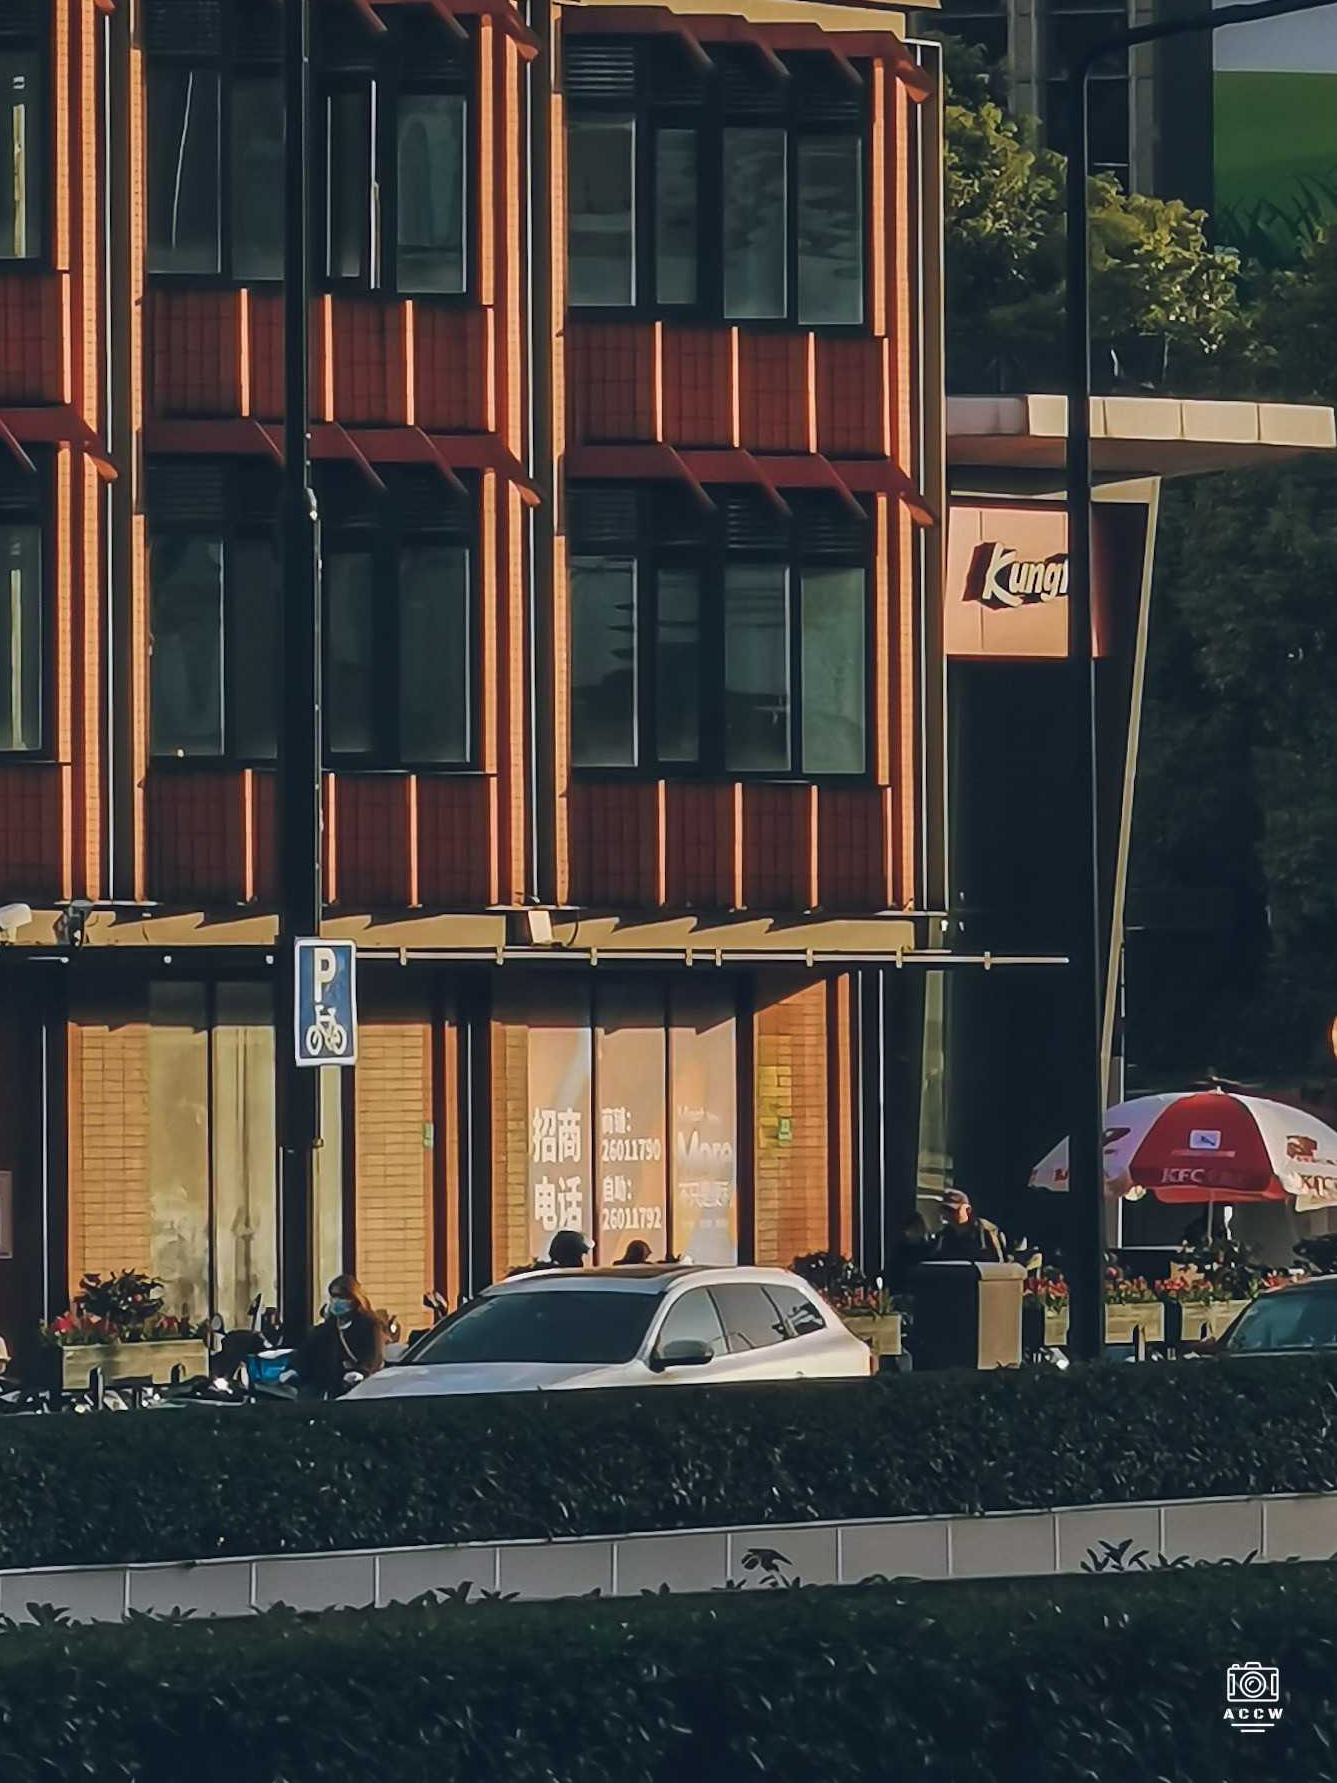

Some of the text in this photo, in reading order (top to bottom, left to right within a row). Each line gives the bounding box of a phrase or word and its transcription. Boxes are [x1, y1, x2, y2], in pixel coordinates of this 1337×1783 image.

[314, 947, 337, 1003] P
[532, 1106, 582, 1163] 招商
[534, 1175, 582, 1231] 电话
[1161, 1167, 1205, 1184] KFC
